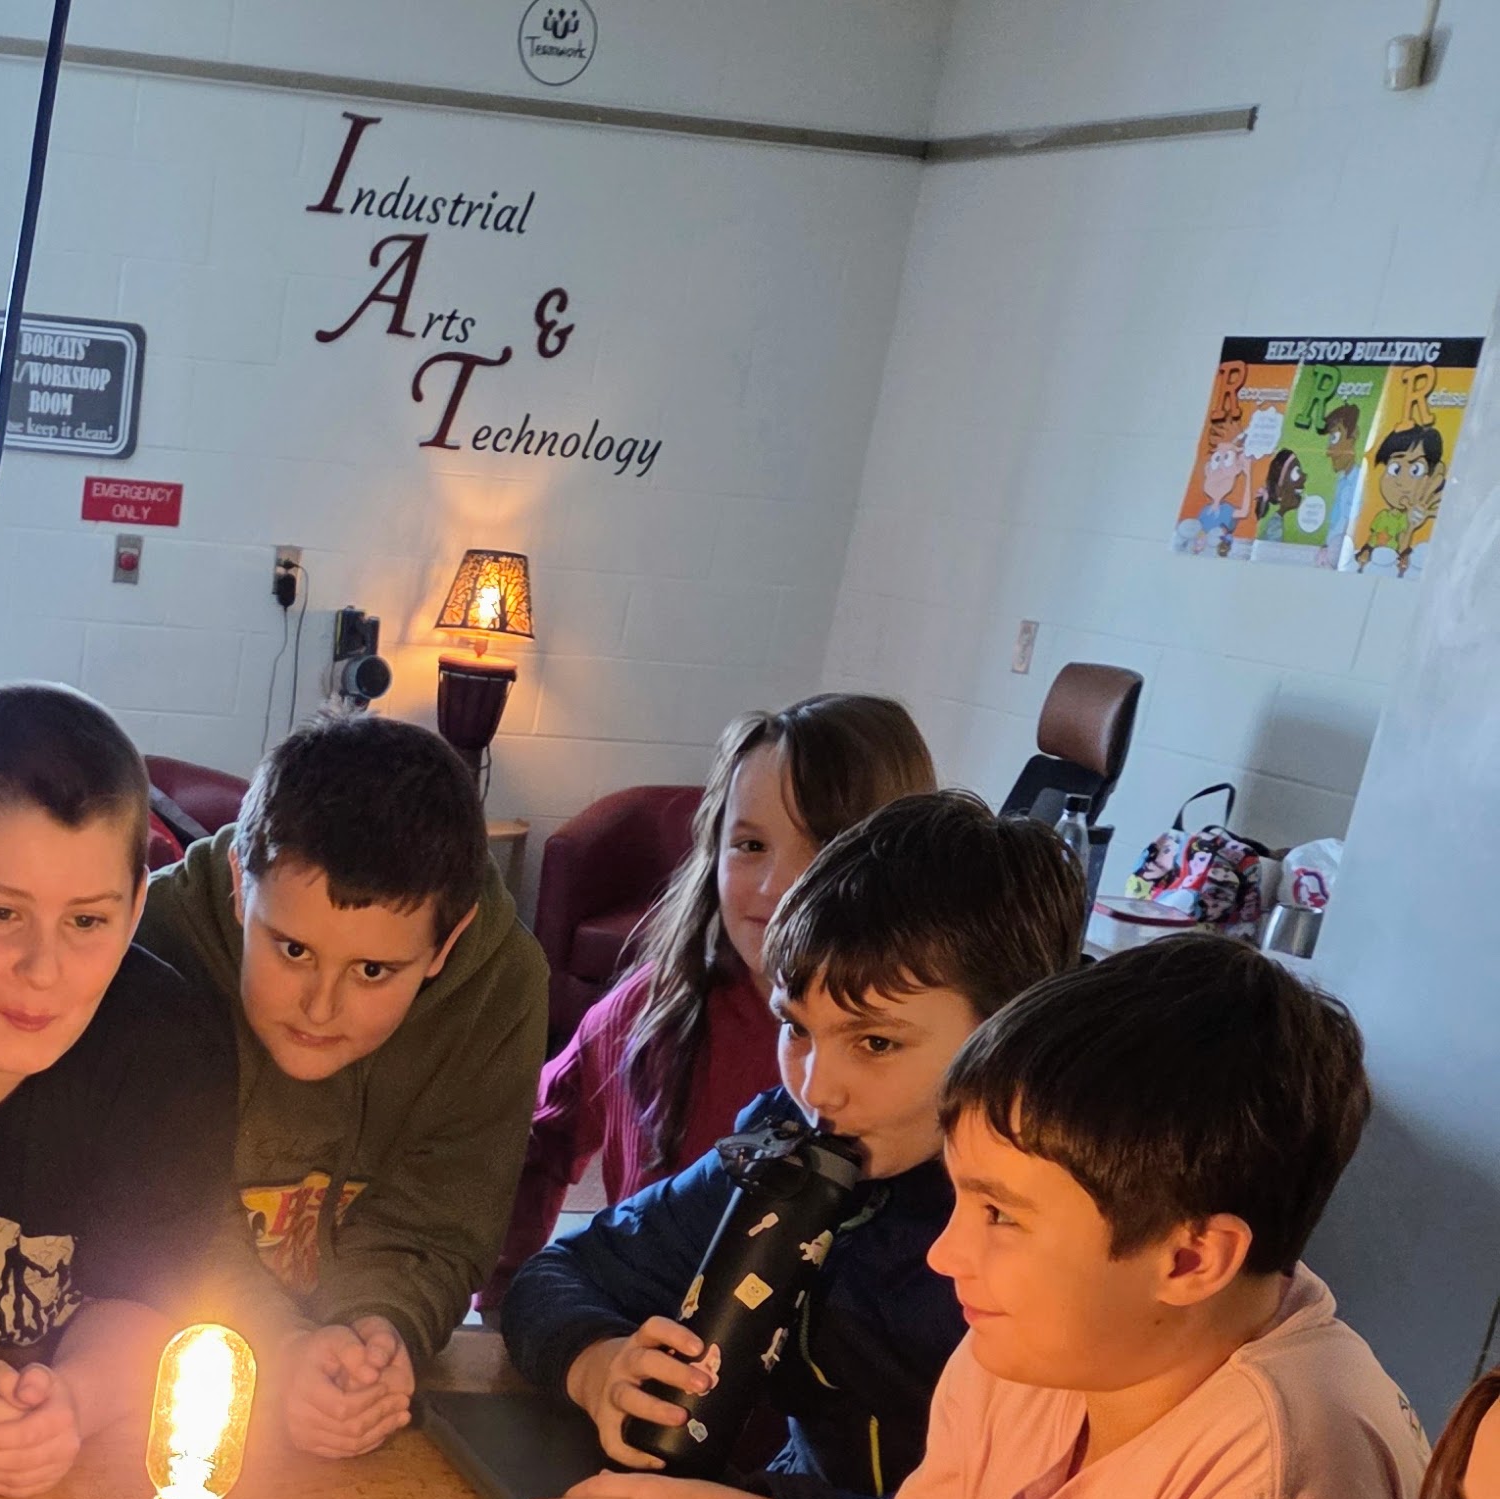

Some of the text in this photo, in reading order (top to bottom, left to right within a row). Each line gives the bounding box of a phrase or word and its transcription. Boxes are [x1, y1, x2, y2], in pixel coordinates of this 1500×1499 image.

[305, 111, 536, 235] Industrial
[315, 233, 576, 359] Arts &
[1304, 341, 1351, 361] STOP
[1351, 341, 1442, 363] BULLYING
[28, 389, 74, 416] ROOM
[411, 345, 663, 478] Technology
[26, 417, 59, 439] keep
[60, 421, 71, 437] it
[73, 422, 115, 442] clean!
[92, 482, 175, 503] EMERGENCY
[112, 503, 152, 521] ONLY
